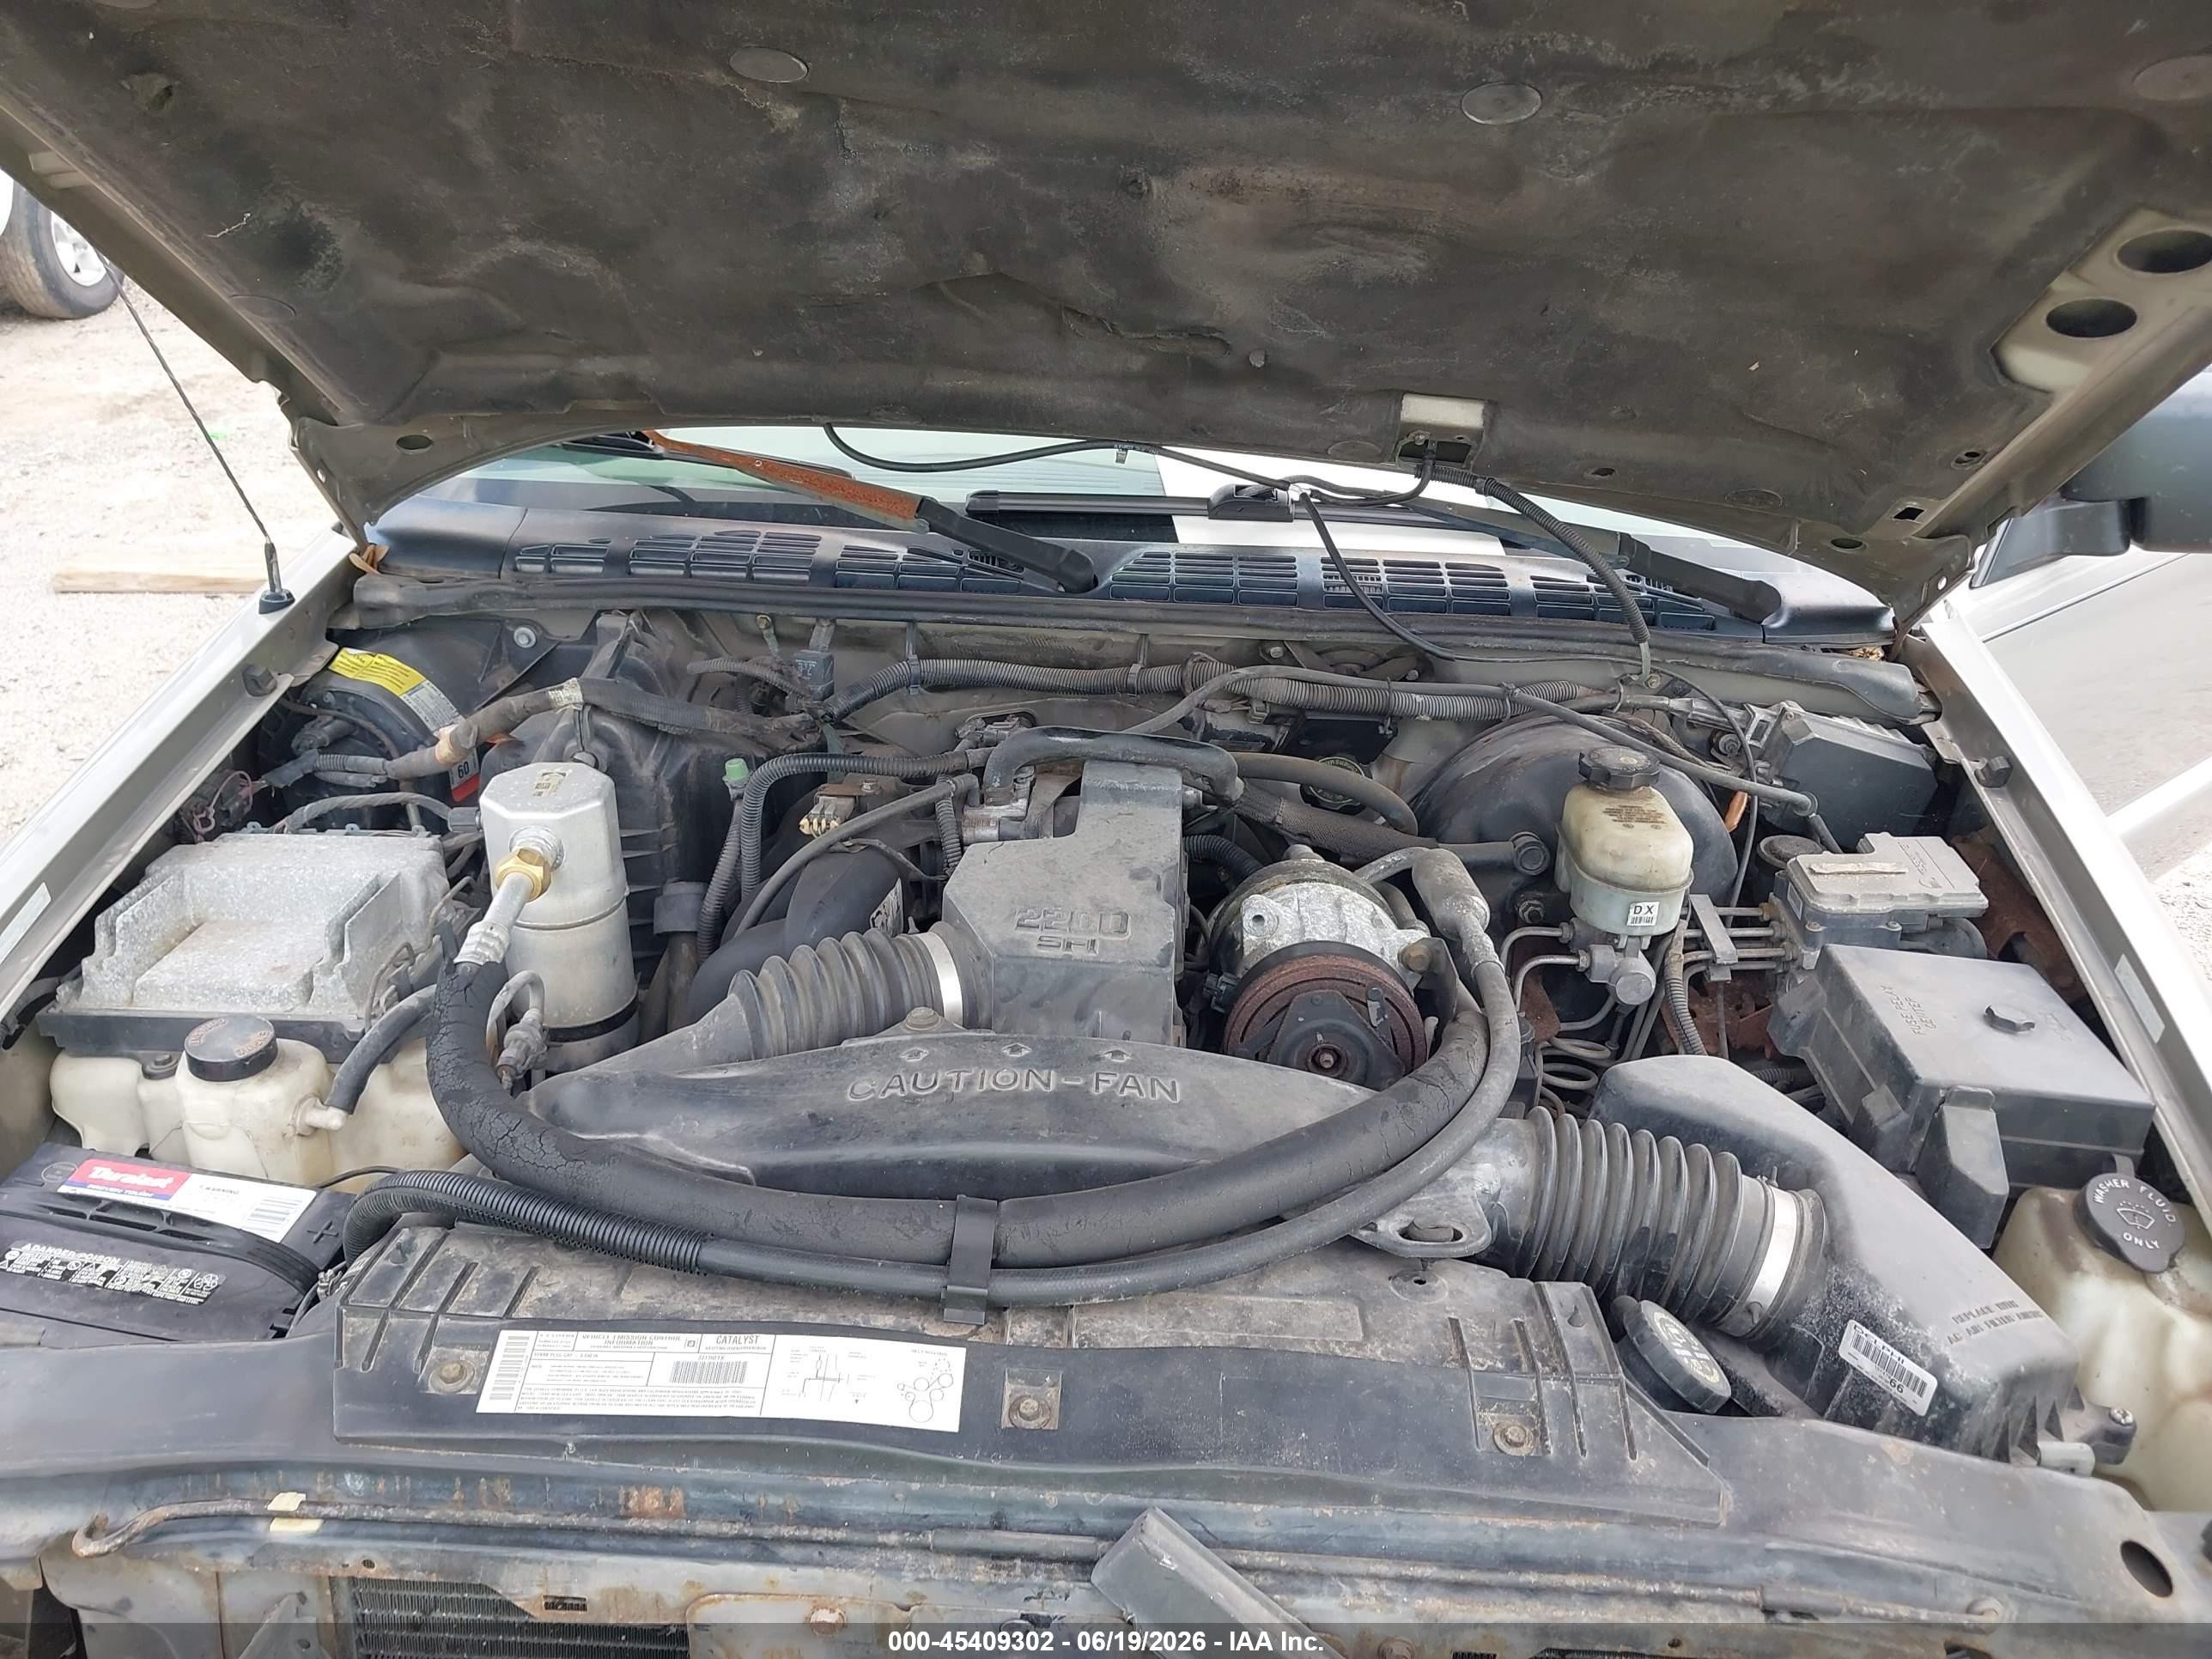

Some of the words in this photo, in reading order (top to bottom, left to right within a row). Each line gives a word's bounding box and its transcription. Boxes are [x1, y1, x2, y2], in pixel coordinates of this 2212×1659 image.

[1014, 906, 1132, 939] 2200
[88, 1165, 174, 1189] Duralast
[2094, 1178, 2130, 1204] WASHER
[2139, 1185, 2177, 1223] FLUID
[2123, 1232, 2160, 1249] ONLY
[716, 1334, 760, 1345] CATALYST
[1889, 1378, 1905, 1394] 66
